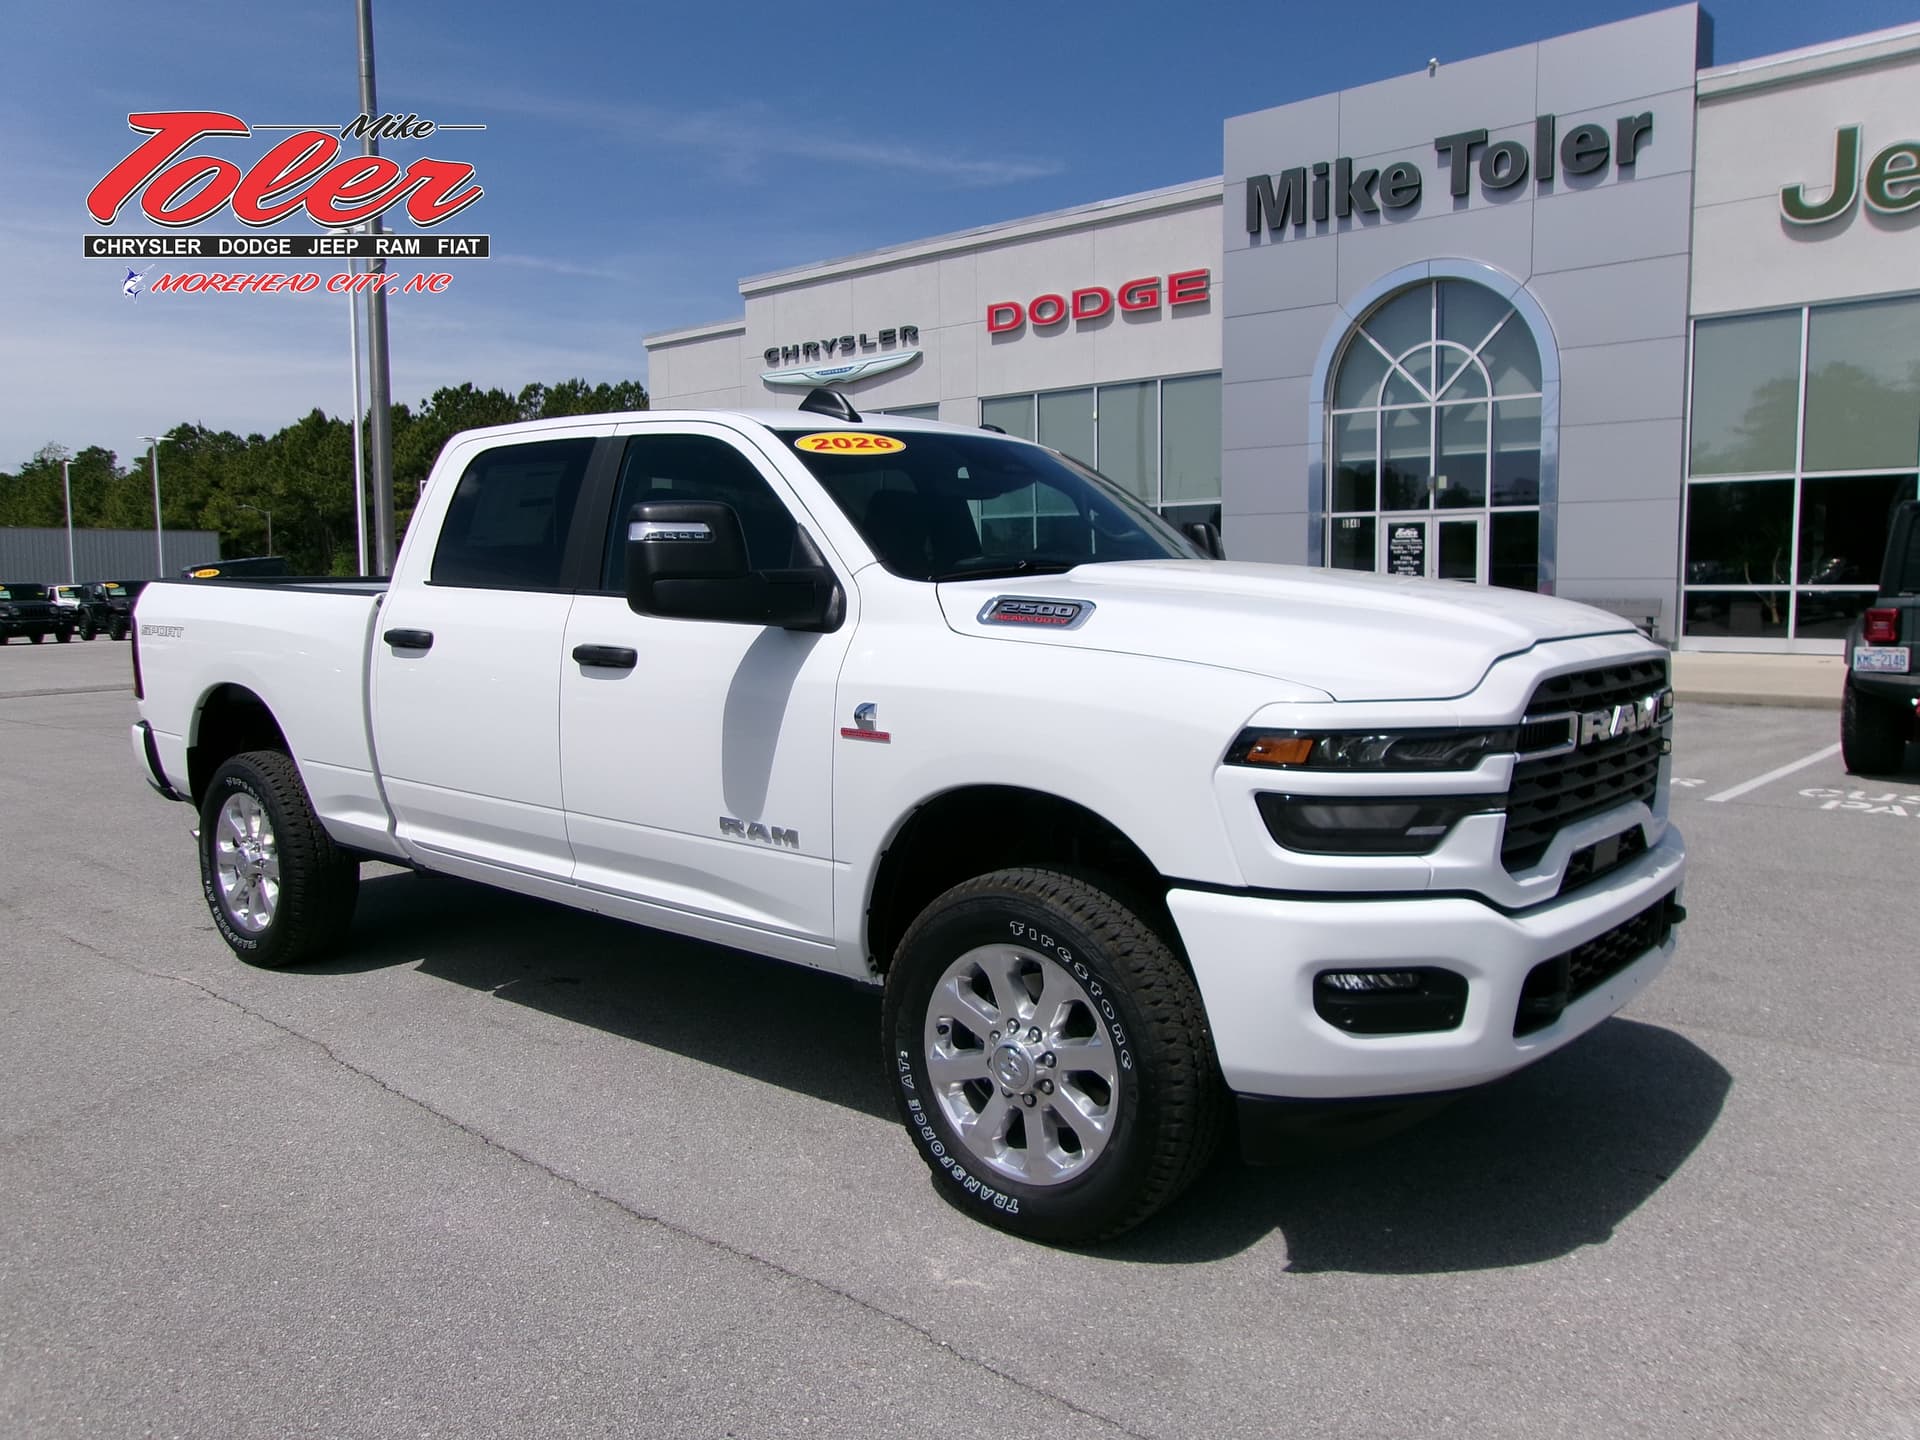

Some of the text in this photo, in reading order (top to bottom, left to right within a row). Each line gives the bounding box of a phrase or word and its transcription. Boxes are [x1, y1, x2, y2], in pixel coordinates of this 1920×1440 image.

[1245, 111, 1654, 233] Mike Toler
[1779, 123, 1920, 225] Je
[986, 268, 1209, 334] DODGE
[763, 325, 920, 363] CHRYSLER
[811, 437, 893, 451] 2026
[141, 624, 184, 638] SPORT
[1001, 602, 1075, 617] 2500
[1580, 698, 1659, 746] RAM
[719, 816, 800, 849] RAM
[898, 1050, 1020, 1214] TRANSFORCE AT2
